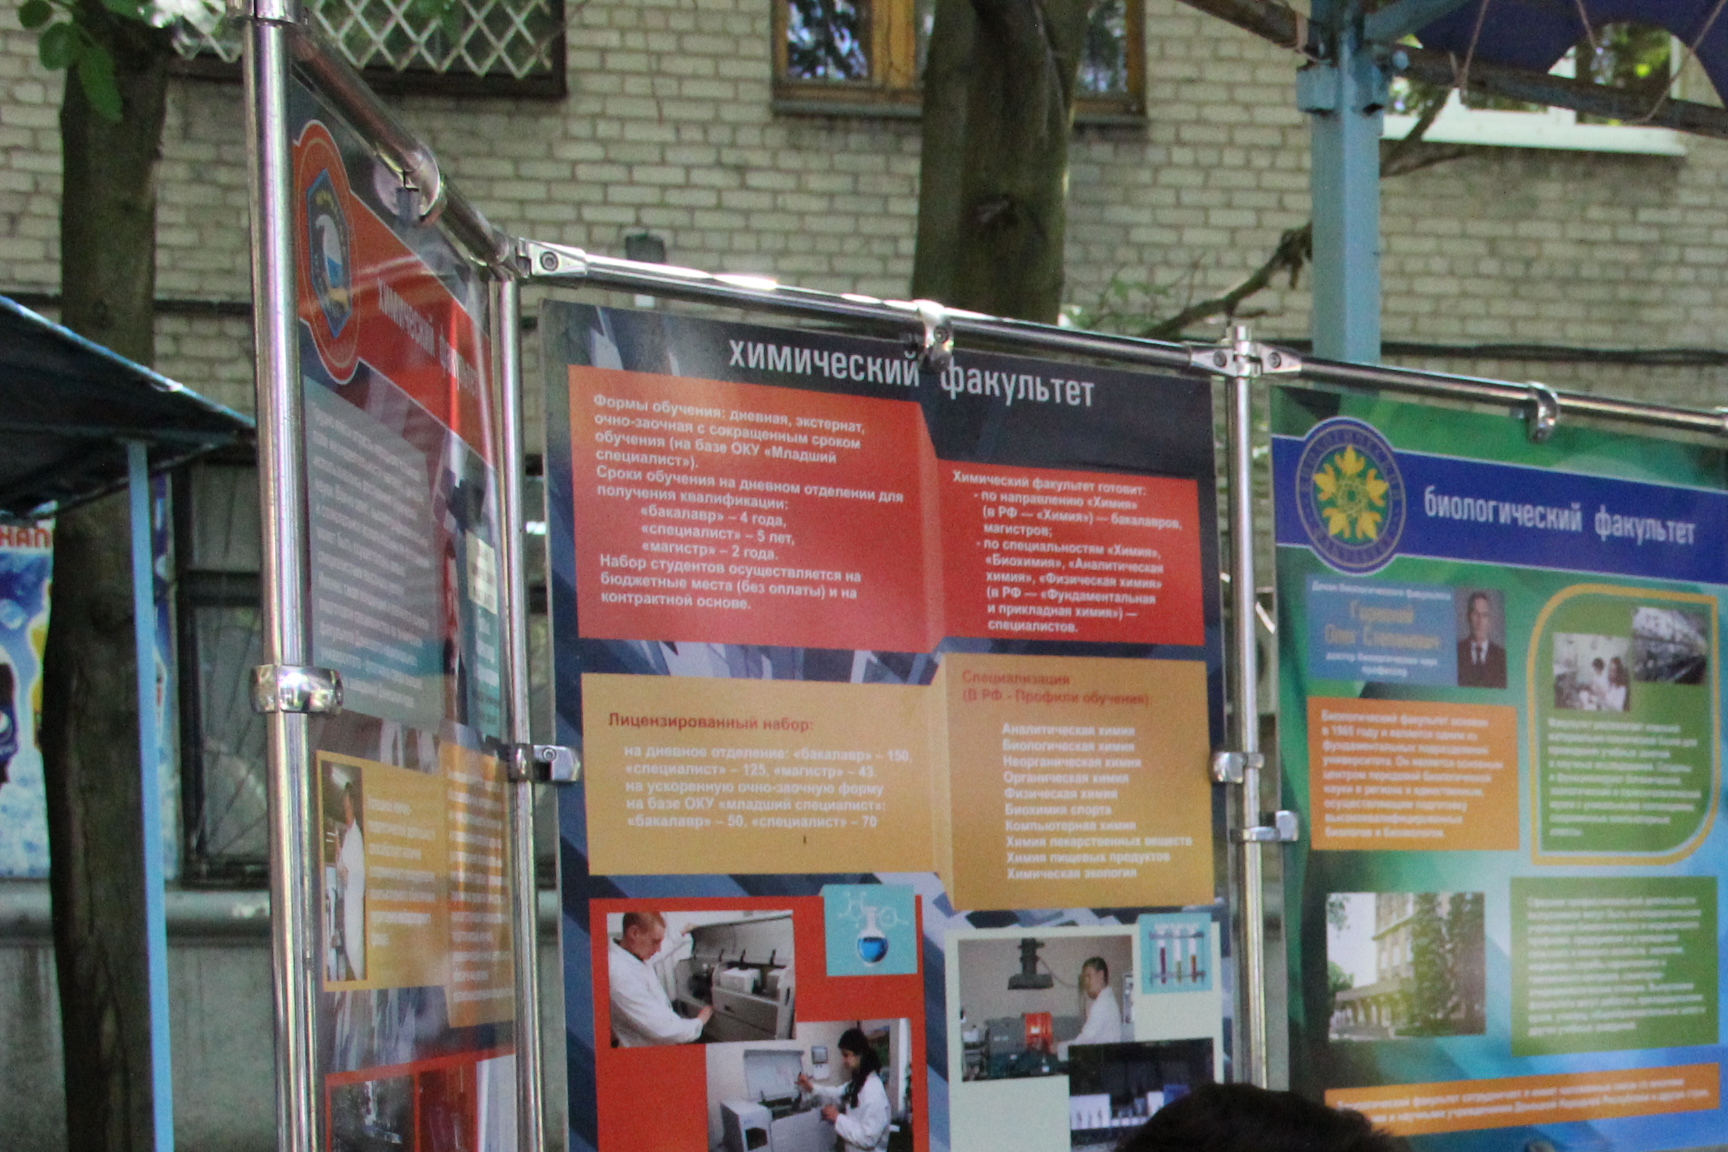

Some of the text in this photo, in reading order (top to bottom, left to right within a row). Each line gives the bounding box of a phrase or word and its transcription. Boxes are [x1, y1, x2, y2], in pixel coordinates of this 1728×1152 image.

[729, 339, 1095, 407] химический факультет
[594, 393, 865, 435] Формы обучения: дневная, экстернат,
[594, 413, 693, 433] очно-заочная
[710, 424, 808, 445] сокращенным
[812, 435, 860, 450] сроком
[595, 431, 837, 464] обучения (на базе ОКУ «Младший
[596, 450, 699, 469] специалист»).
[597, 465, 904, 503] Сроки обучения на дневном отделении для
[953, 470, 1146, 496] Химический факультет готовит:
[597, 484, 789, 510] получения квалификации:
[981, 491, 1137, 510] по направлению «Химия»
[641, 505, 724, 524] «бакалавр»
[752, 514, 787, 528] года,
[998, 506, 1017, 519] РФ
[1111, 514, 1183, 530] бакалавров,
[1424, 484, 1696, 546] биологический факультет
[641, 523, 741, 542] «специалист»
[769, 533, 795, 546] лет,
[984, 523, 1052, 538] магистров;
[642, 540, 715, 558] «магистр»
[744, 548, 779, 561] года.
[1003, 540, 1104, 555] специальностям
[600, 554, 861, 582] Набор студентов осуществляется на
[1069, 557, 1164, 574] «Аналитическая
[600, 572, 687, 590] бюджетные
[691, 578, 733, 592] места
[737, 580, 765, 596] (без
[769, 583, 825, 600] оплаты)
[841, 588, 857, 599] на
[1039, 572, 1117, 588] «Физическая
[601, 590, 751, 610] контрактной основе.
[1002, 586, 1156, 605] РФ «Фундаментальная
[999, 605, 1072, 619] прикладная
[988, 619, 1078, 633] специалистов.
[609, 712, 814, 733] Лицензированный набор:
